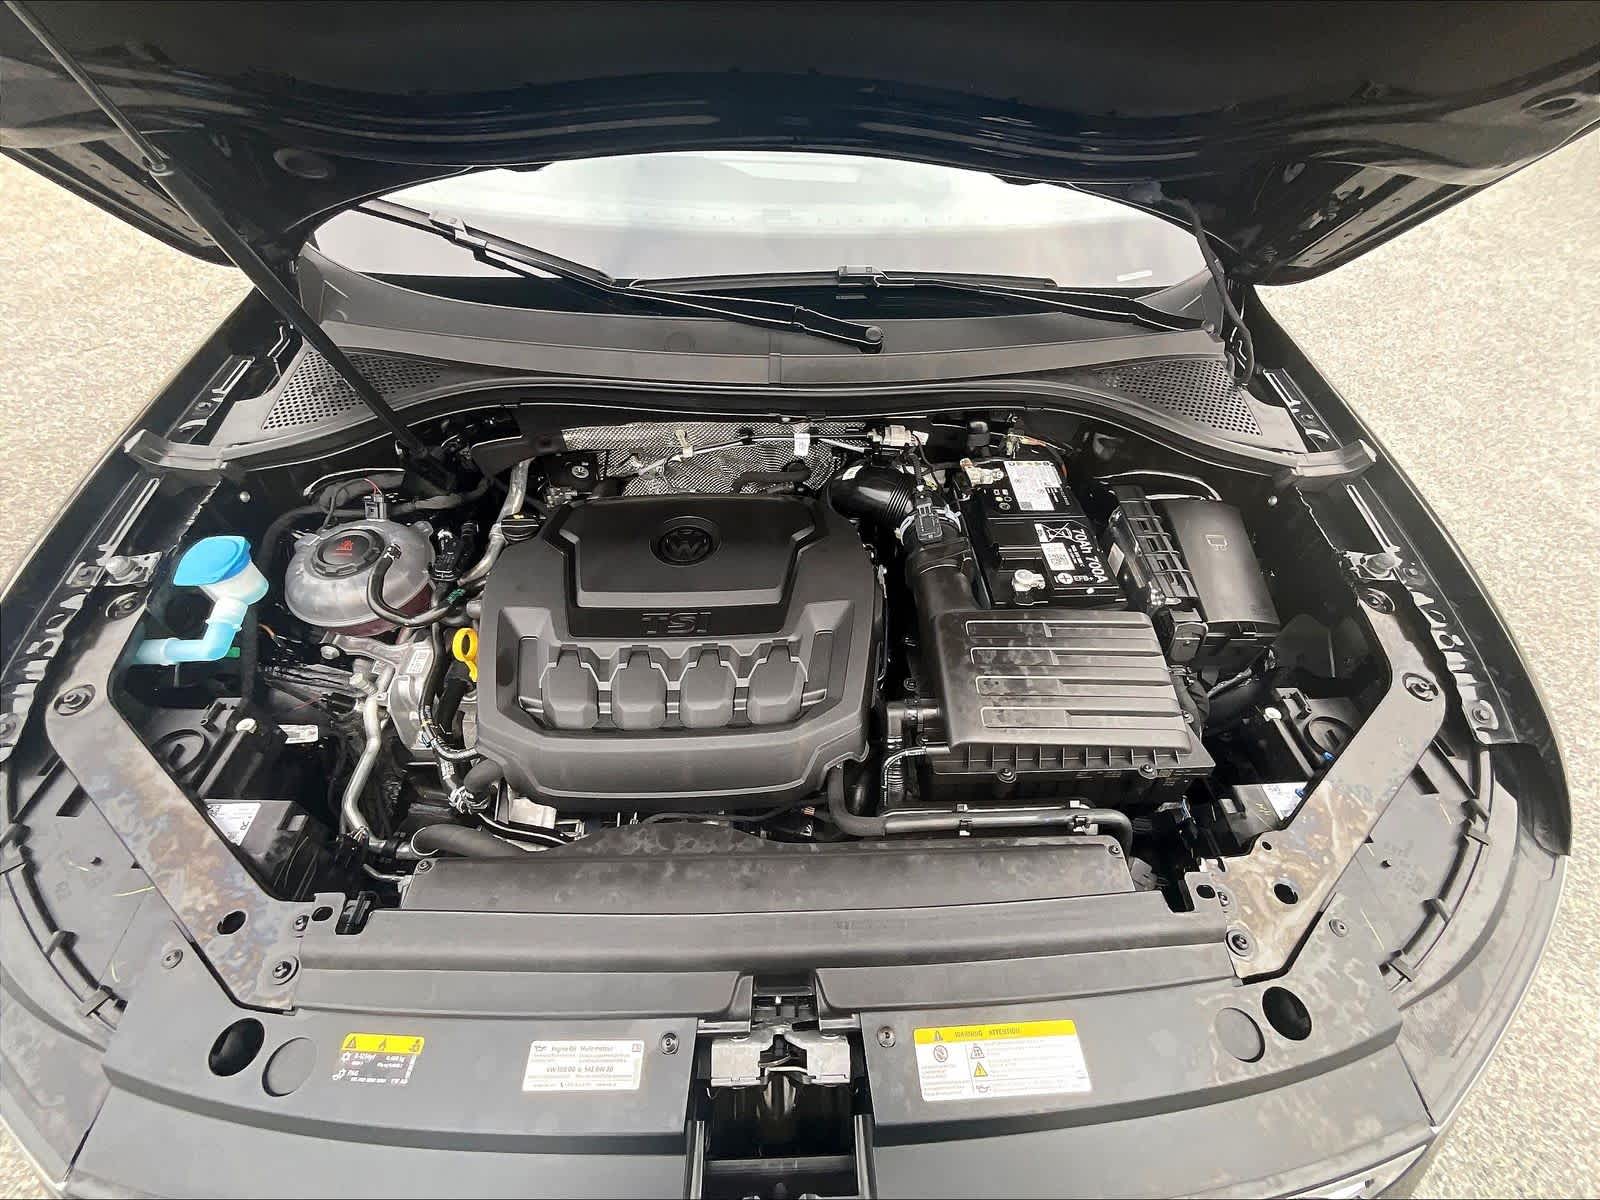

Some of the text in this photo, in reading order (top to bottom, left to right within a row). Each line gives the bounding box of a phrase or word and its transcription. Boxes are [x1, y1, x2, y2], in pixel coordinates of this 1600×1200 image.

[1072, 529, 1093, 553] 70Ah
[1085, 555, 1109, 583] 700A
[642, 611, 712, 635] TSI
